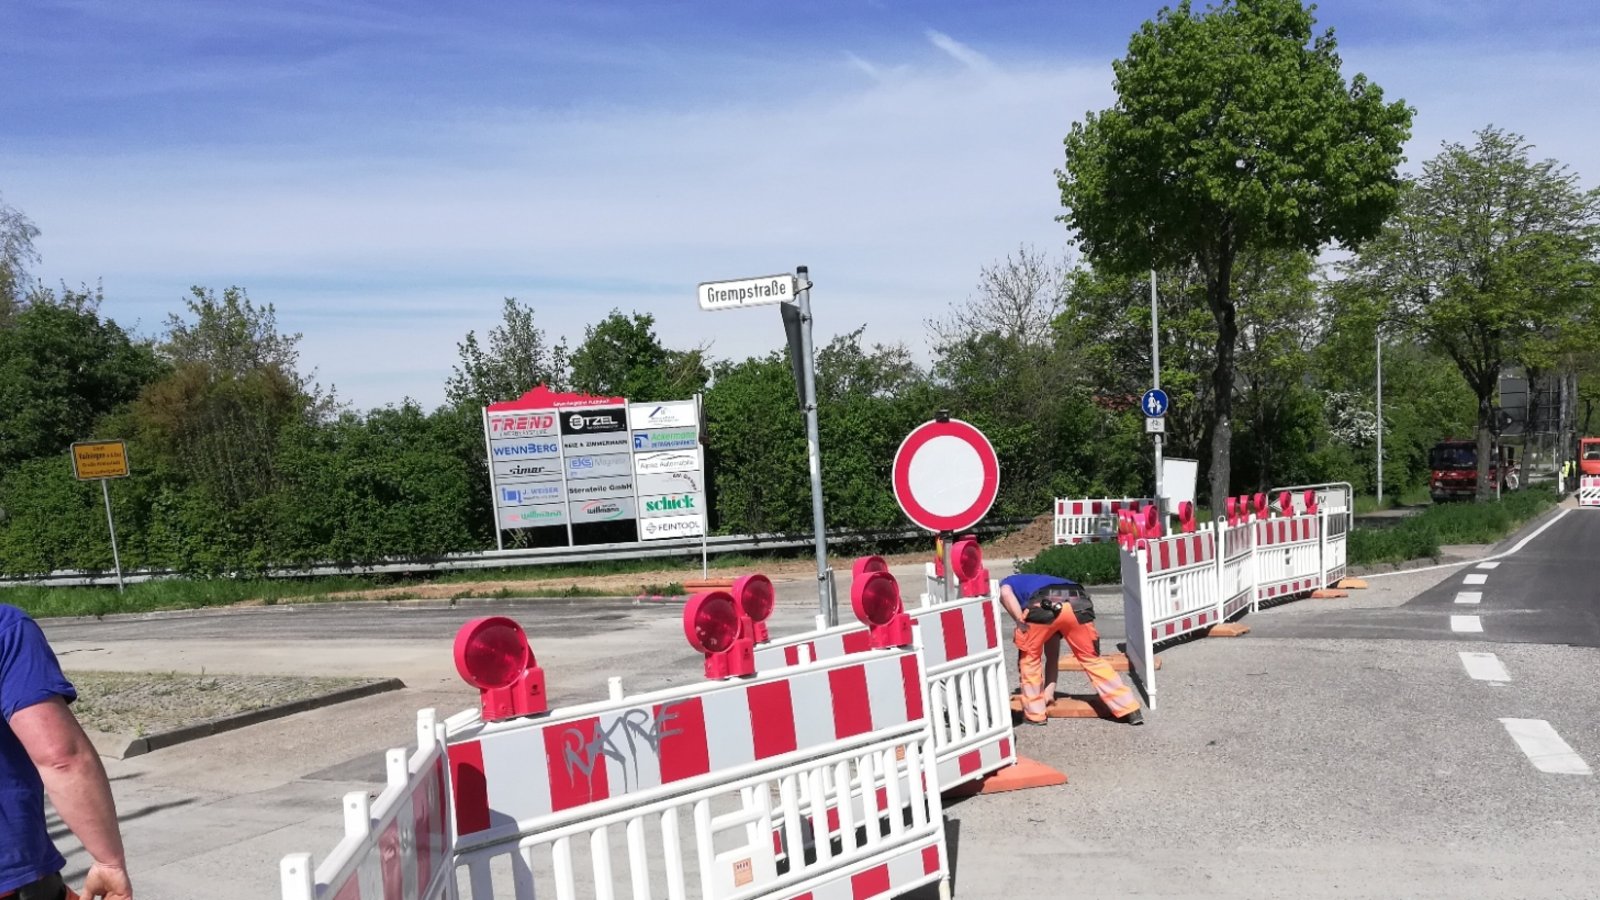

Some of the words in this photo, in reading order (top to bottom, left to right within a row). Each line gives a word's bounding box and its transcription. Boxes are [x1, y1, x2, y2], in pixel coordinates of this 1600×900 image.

[707, 279, 786, 304] Grempstraße
[491, 415, 554, 432] TREND
[493, 443, 558, 456] WENNBERG
[609, 483, 632, 491] GmbH
[646, 494, 695, 512] schick
[658, 521, 700, 532] FEINTOOL
